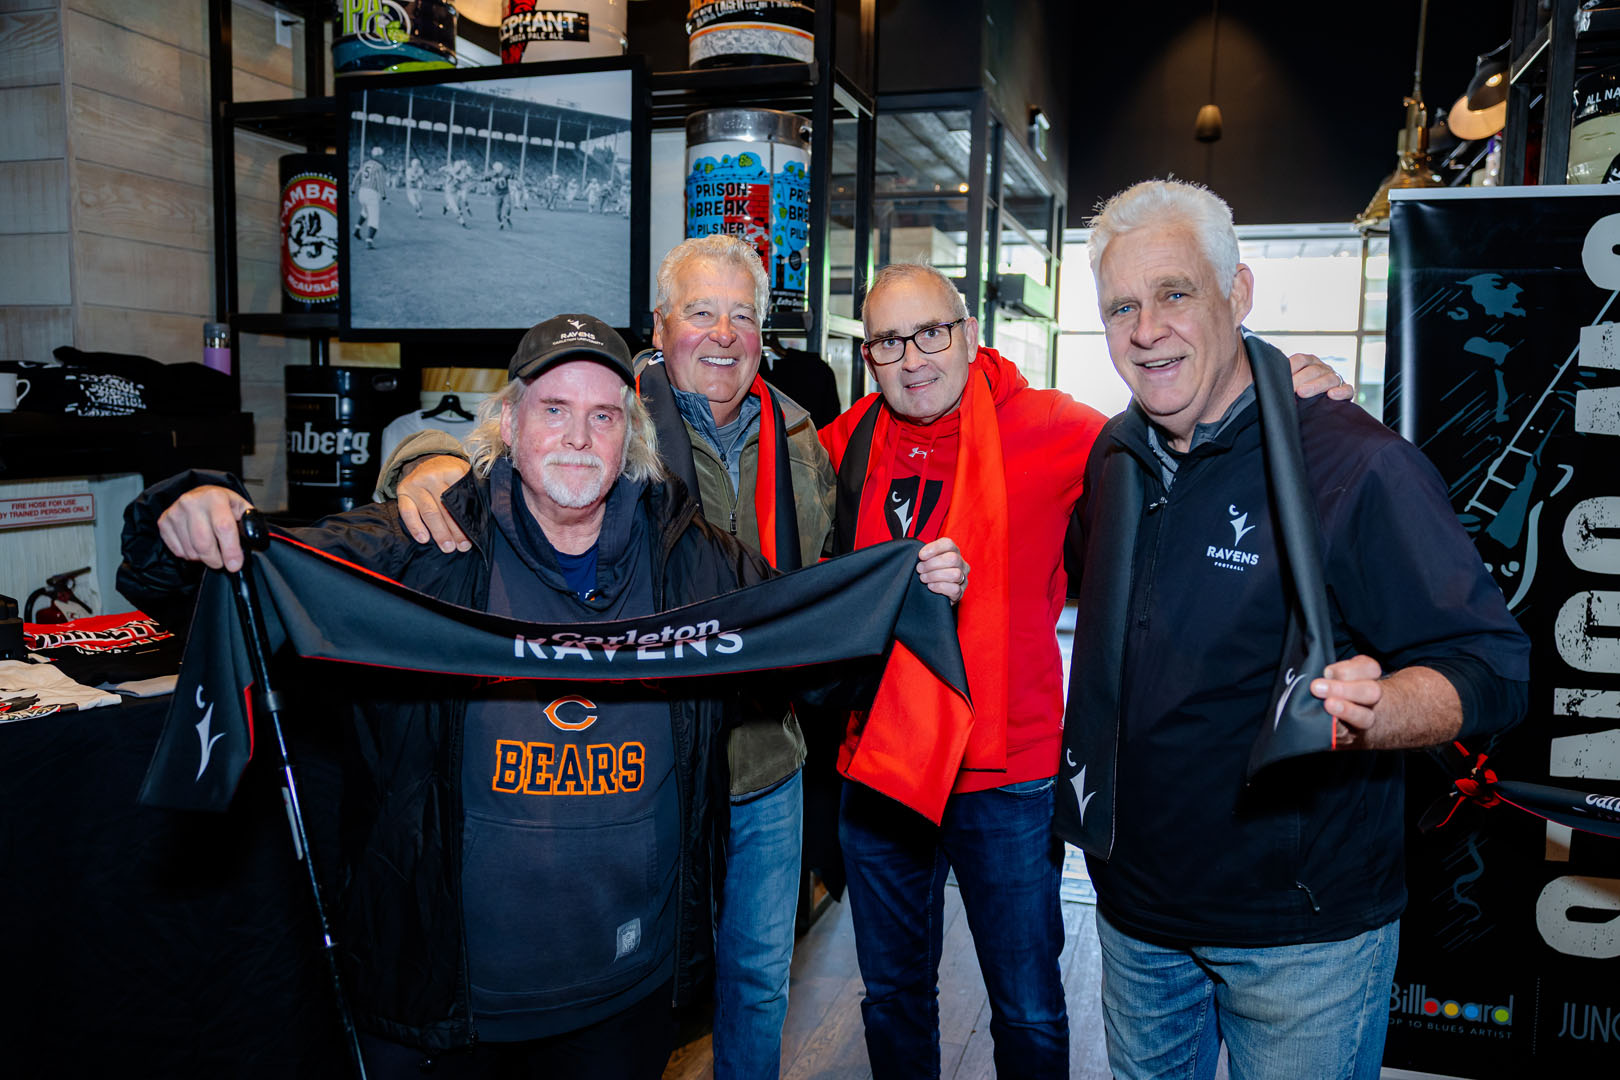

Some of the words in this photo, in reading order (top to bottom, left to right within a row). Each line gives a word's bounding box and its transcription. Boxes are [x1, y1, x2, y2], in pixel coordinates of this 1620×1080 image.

[527, 32, 546, 40] PALE
[548, 32, 564, 40] ALE
[1585, 91, 1602, 106] ALL
[696, 182, 749, 198] PRISON
[695, 200, 750, 218] BREAK
[697, 222, 746, 235] PILSNER
[560, 331, 596, 340] RAVENS
[9, 509, 39, 518] TRAINED
[40, 507, 72, 515] PERSONS
[72, 505, 90, 513] ONLY
[11, 502, 26, 510] FIRE
[28, 501, 47, 509] HOSE
[1206, 545, 1260, 565] RAVENS
[1214, 561, 1244, 571] FOOTBALL
[552, 619, 721, 645] Carleton
[492, 739, 646, 796] BEARS
[1389, 982, 1514, 1027] Billboard
[1427, 1022, 1464, 1034] BLUES
[1470, 1027, 1513, 1039] ARTIST
